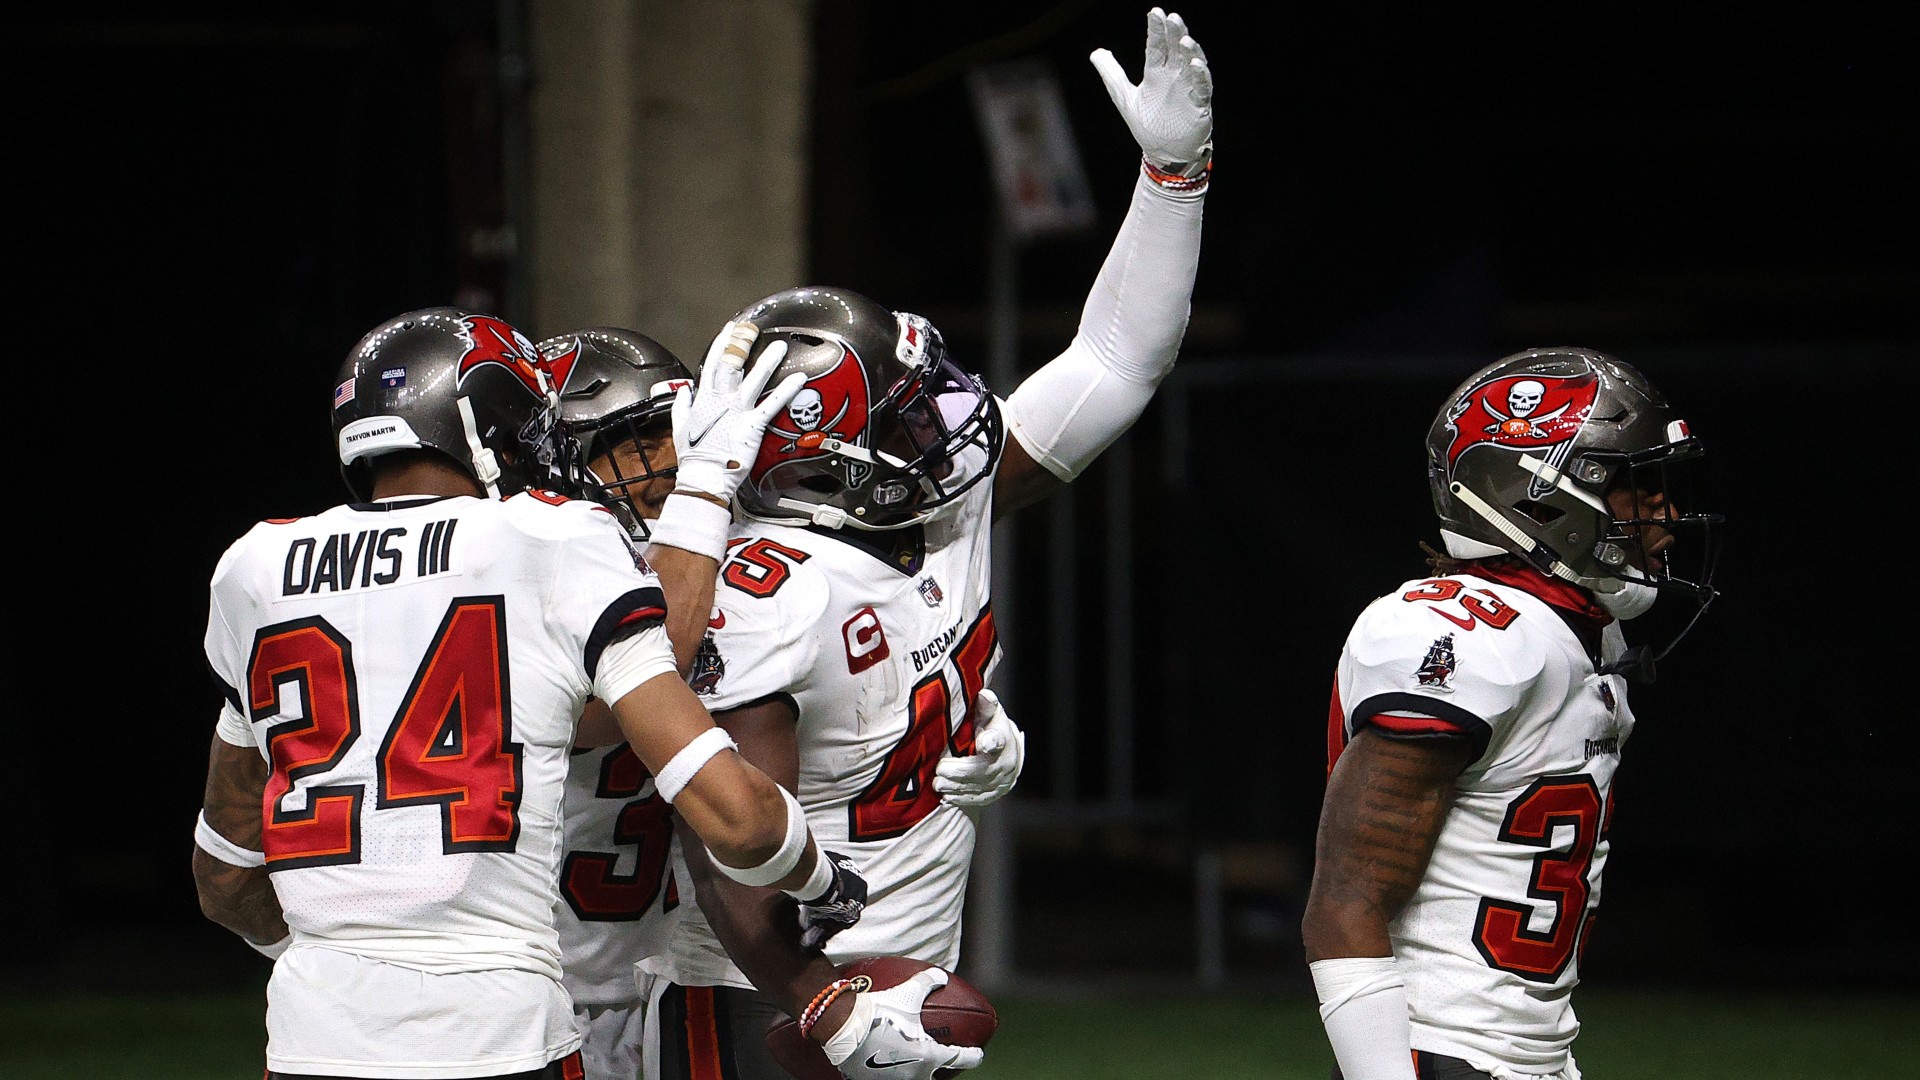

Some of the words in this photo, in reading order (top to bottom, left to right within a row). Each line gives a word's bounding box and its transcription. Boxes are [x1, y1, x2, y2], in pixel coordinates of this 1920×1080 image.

[346, 431, 371, 443] TRAYVON
[371, 426, 396, 437] MARTIN
[282, 527, 408, 597] DAVIS
[417, 518, 458, 577] III
[717, 537, 812, 599] 5
[846, 612, 882, 659] C
[910, 615, 963, 672] BUCCAN
[246, 594, 524, 873] 24
[560, 741, 680, 921] 3
[1472, 773, 1616, 984] 3
